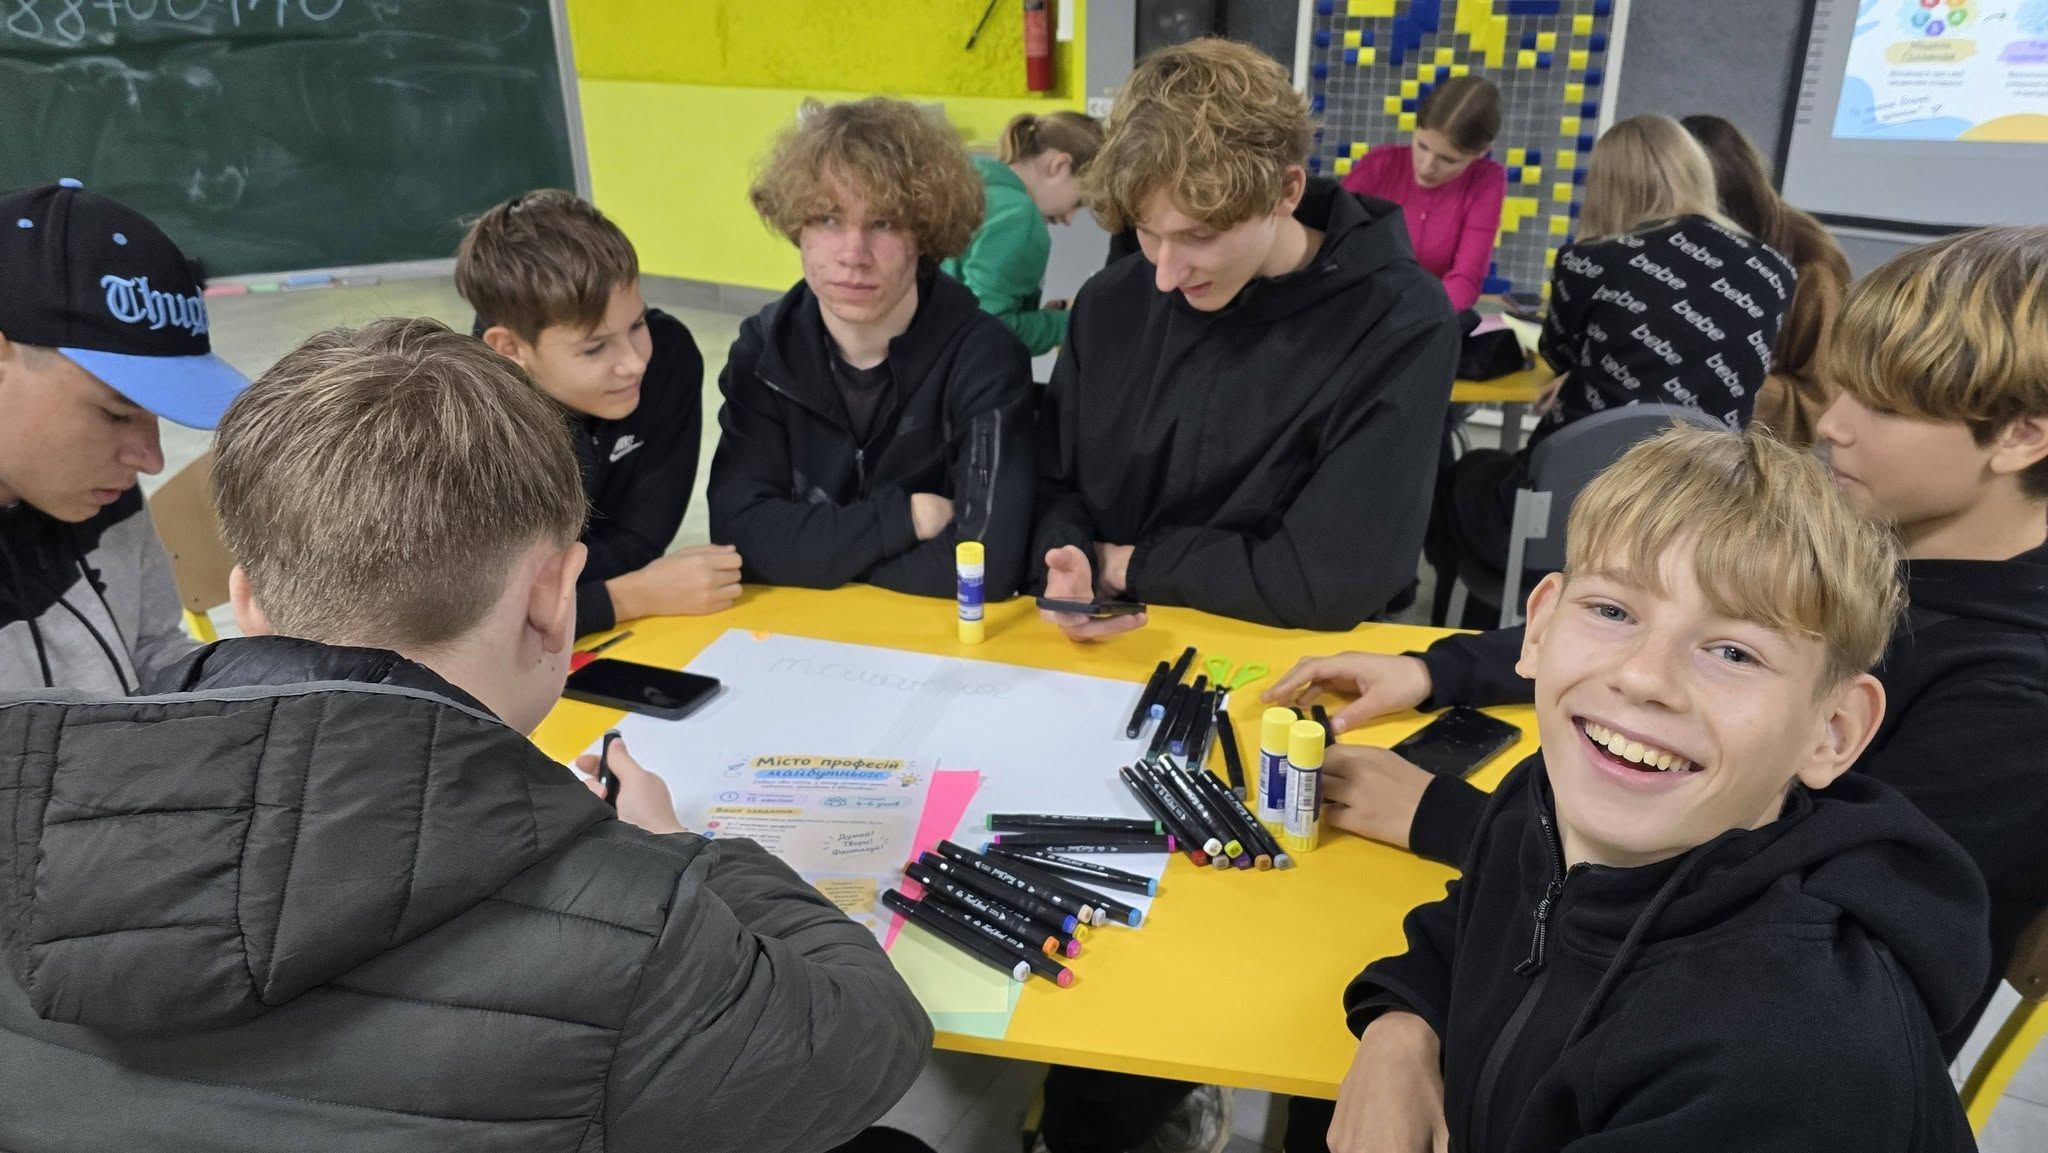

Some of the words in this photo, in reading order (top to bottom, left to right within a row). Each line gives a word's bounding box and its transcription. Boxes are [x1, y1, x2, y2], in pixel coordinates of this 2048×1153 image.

[1561, 249, 1605, 279] bebe
[1667, 231, 1724, 269] bebe
[1628, 252, 1688, 290] bebe
[1710, 277, 1764, 318] bebe
[1671, 299, 1726, 342] bebe
[1630, 323, 1683, 366] bebe
[1600, 354, 1640, 391] bebe
[1706, 352, 1745, 398] bebe
[1662, 376, 1699, 409] beb
[756, 757, 811, 767] Місто
[820, 758, 900, 770] професій
[768, 767, 884, 780] майбутнього
